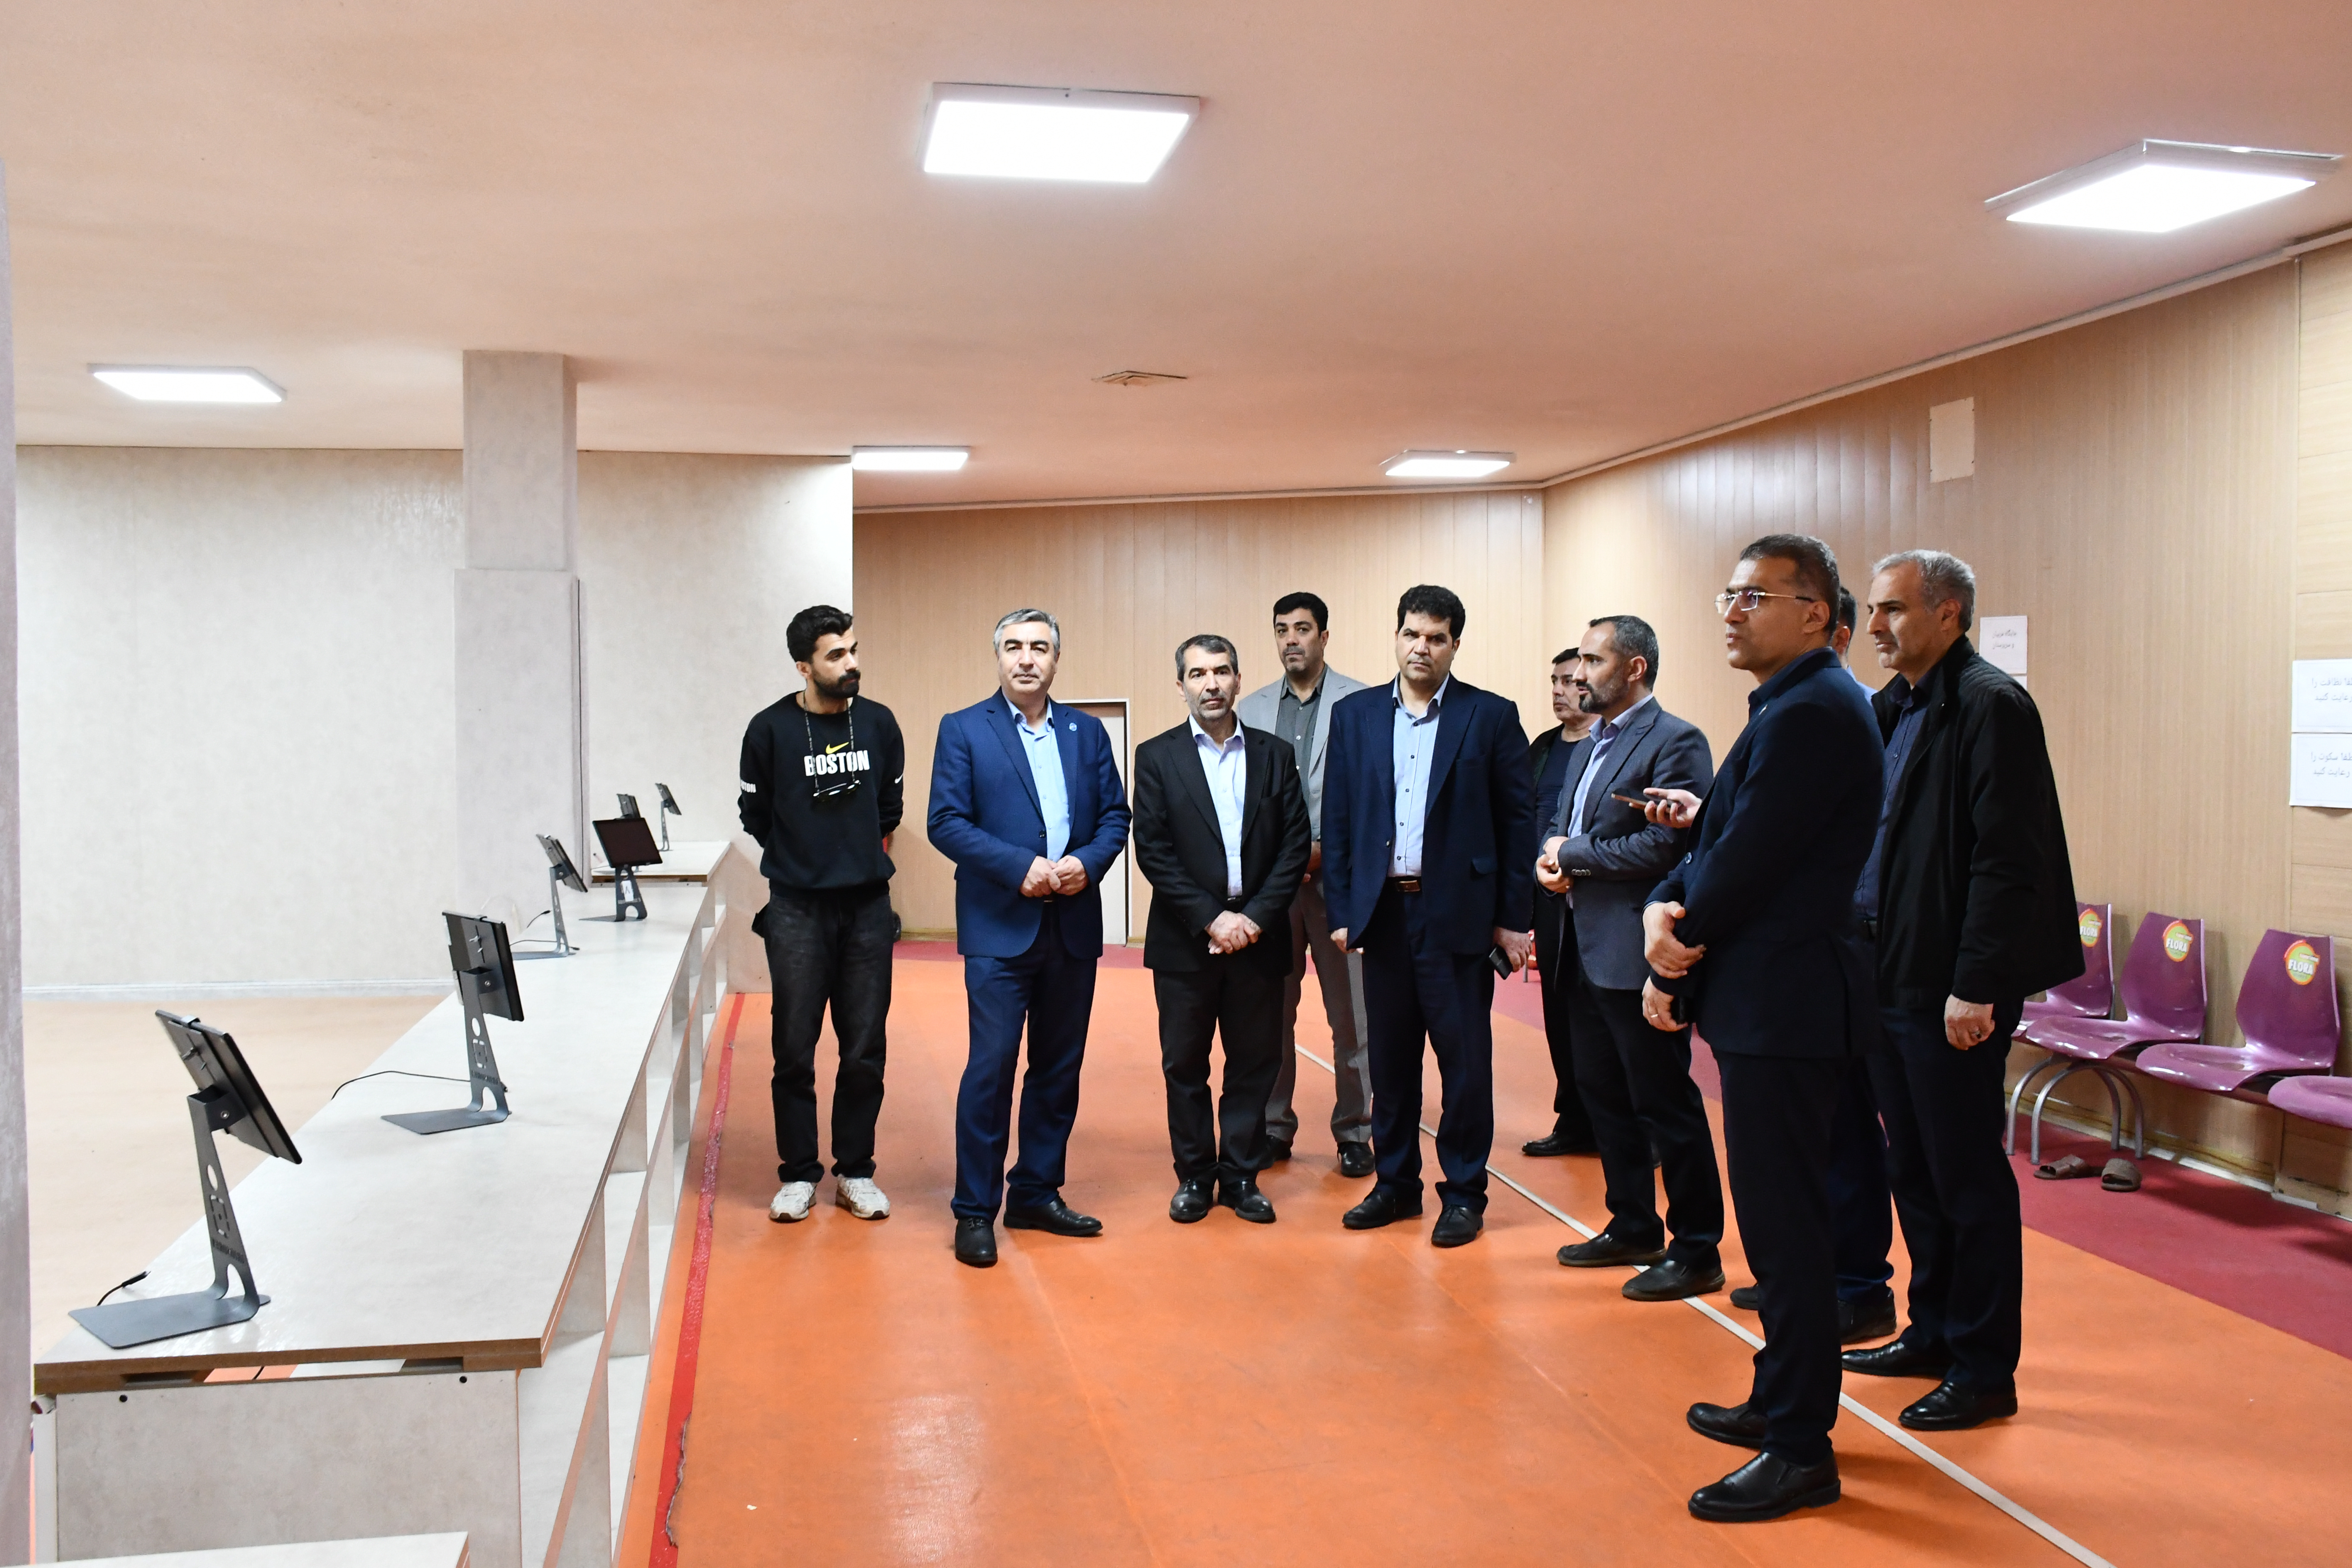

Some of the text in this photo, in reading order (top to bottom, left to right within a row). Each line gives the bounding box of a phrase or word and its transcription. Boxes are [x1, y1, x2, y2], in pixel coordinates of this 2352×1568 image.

[2311, 678, 2317, 688] را
[2315, 692, 2329, 702] کنید
[2311, 752, 2316, 762] را
[2318, 752, 2338, 762] سکوت
[804, 750, 870, 776] BOSTON
[2313, 767, 2350, 778] رعایت کنید
[2166, 937, 2188, 953] FLORA
[2288, 958, 2314, 975] FLORA
